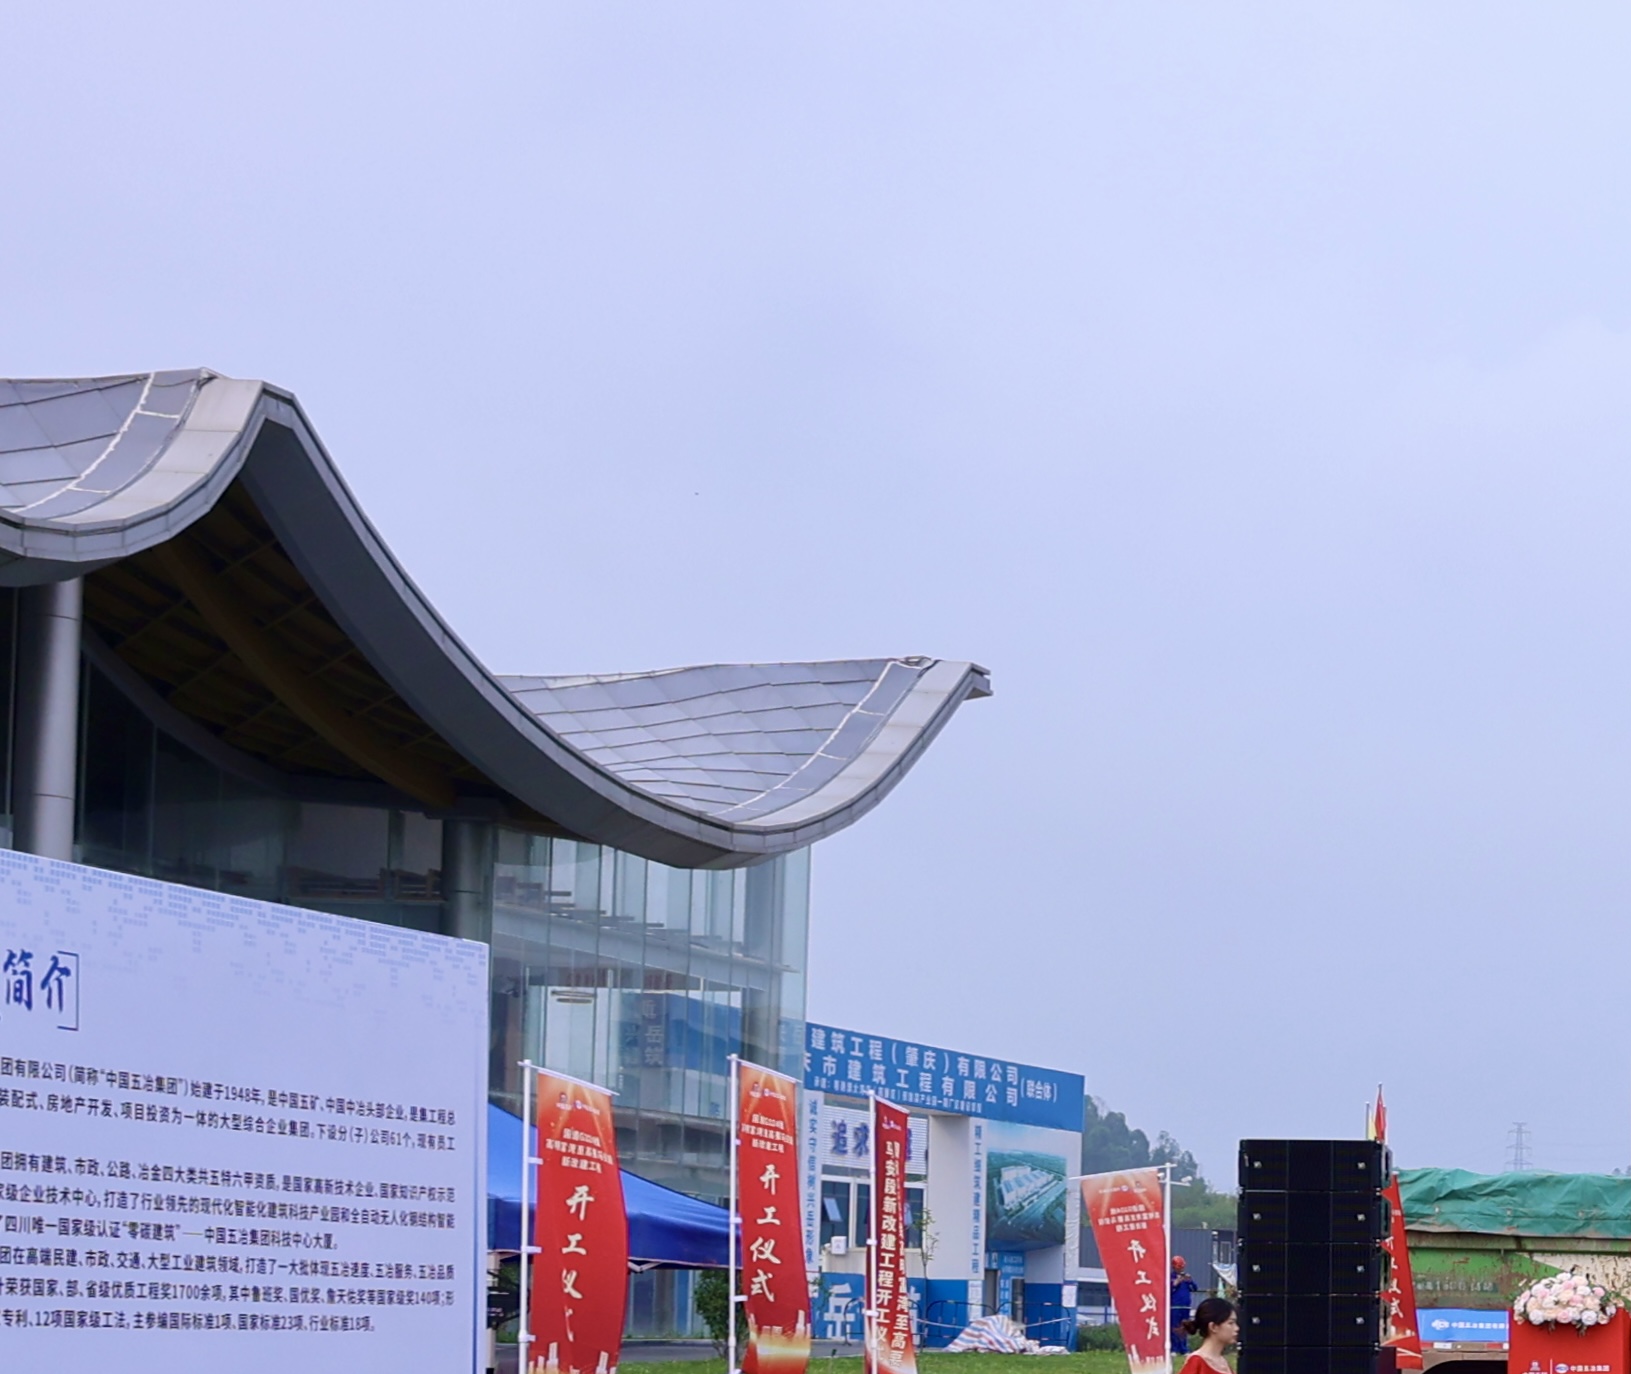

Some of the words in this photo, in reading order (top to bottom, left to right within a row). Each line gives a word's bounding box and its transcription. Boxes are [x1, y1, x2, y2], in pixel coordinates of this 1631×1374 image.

[3, 949, 71, 1013] 简介
[750, 1164, 782, 1302] 开工仪式
